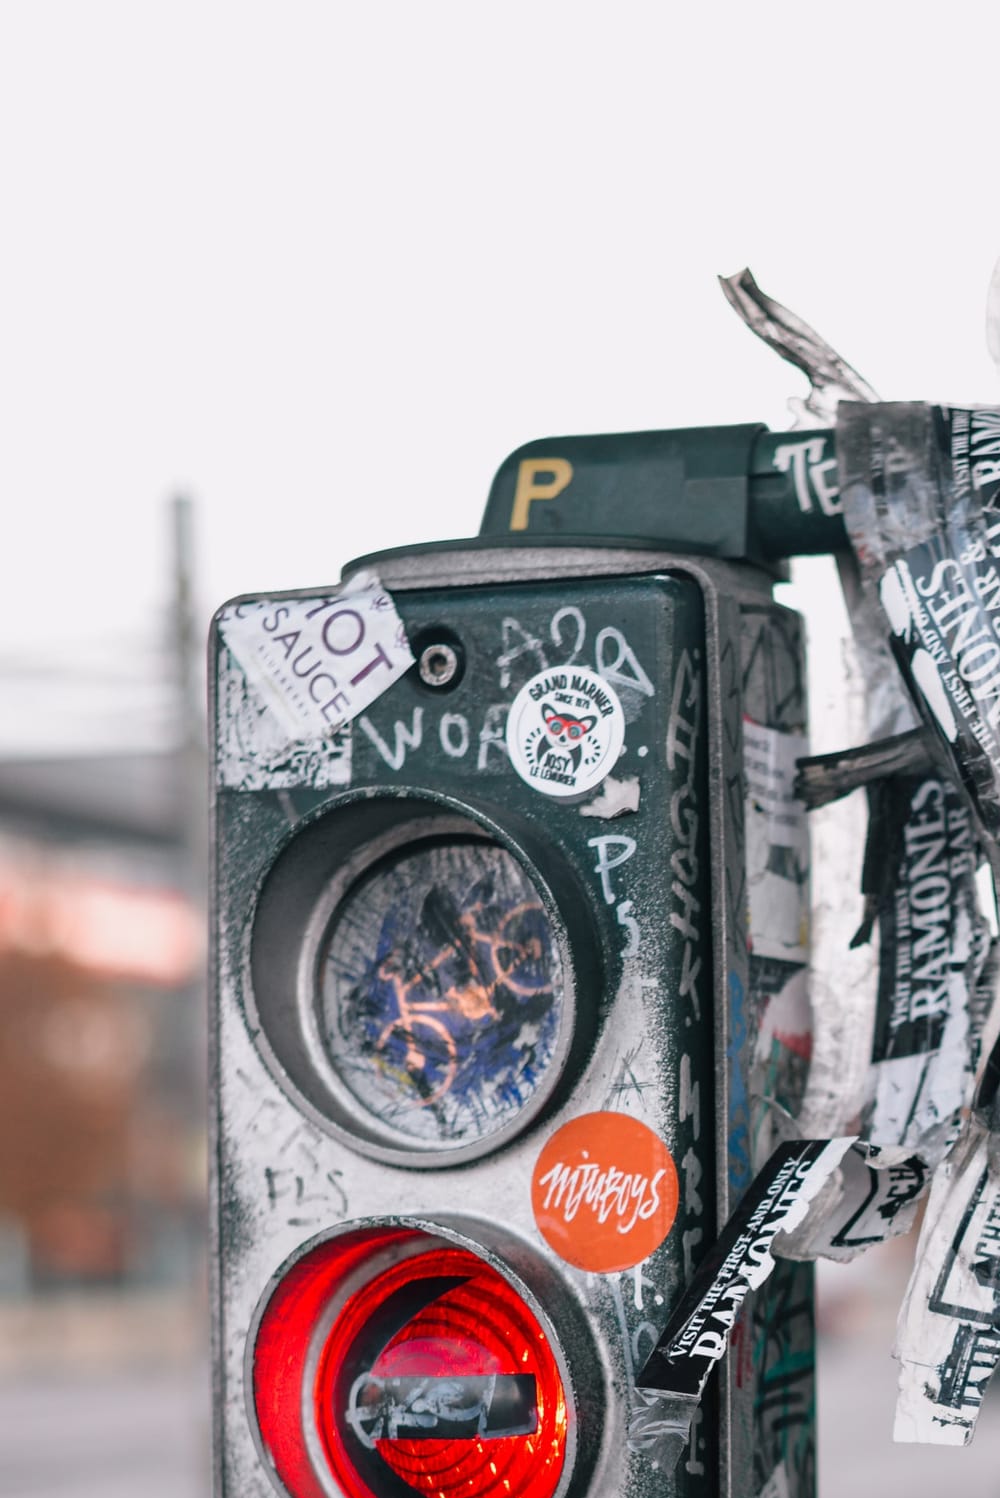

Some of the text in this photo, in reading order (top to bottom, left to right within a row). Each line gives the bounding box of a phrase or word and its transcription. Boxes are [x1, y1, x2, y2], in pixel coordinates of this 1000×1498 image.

[510, 457, 574, 531] P
[262, 607, 351, 723] SAUCE
[528, 674, 614, 718] GRAND MARNIER
[543, 753, 572, 773] JOSY
[904, 779, 952, 1023] RAMONES
[669, 1314, 706, 1359] VISIT
[700, 1280, 726, 1312] THE
[717, 1234, 752, 1279] FIRST
[746, 1199, 770, 1232] AND
[767, 1157, 800, 1197] ONLY
